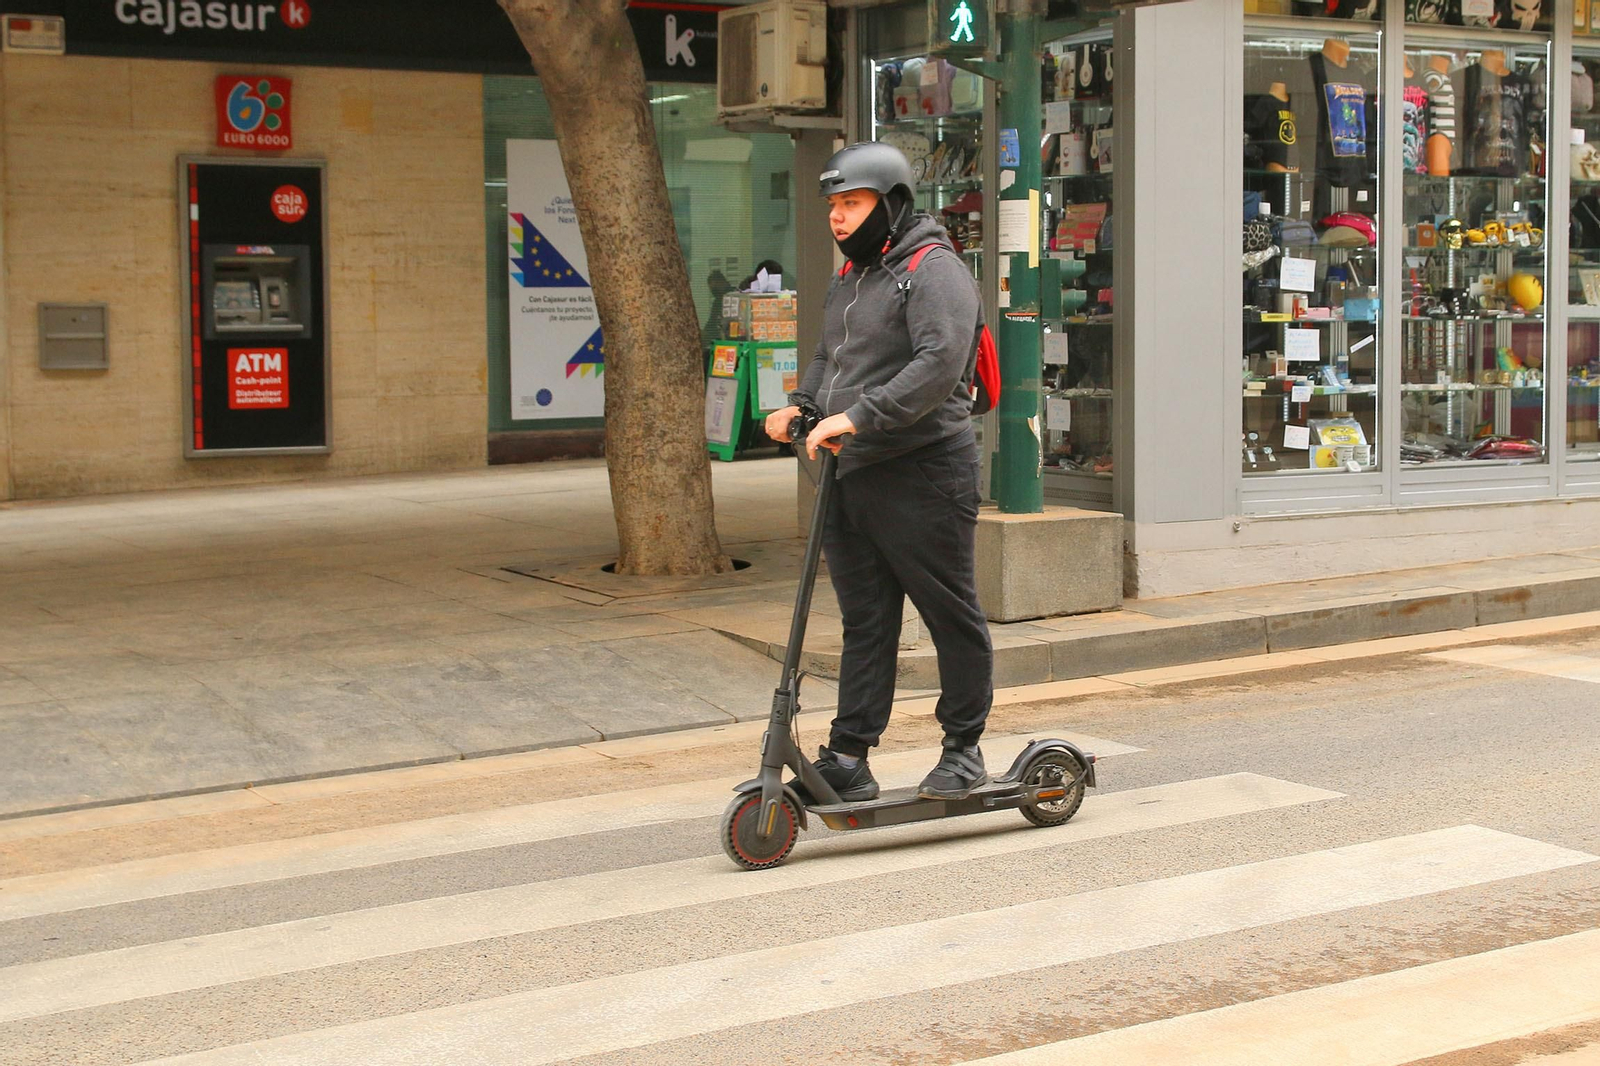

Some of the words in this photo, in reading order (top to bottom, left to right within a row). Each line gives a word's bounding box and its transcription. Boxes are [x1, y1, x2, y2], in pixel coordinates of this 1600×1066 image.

[115, 0, 276, 35] cajasur
[223, 132, 255, 145] EURO
[257, 133, 290, 146] 6000
[274, 190, 303, 207] caja
[528, 295, 542, 303] Con
[543, 295, 568, 304] Cajasur
[521, 305, 556, 313] Cuéntanos
[235, 353, 282, 373] ATM
[235, 376, 282, 386] Cash-point
